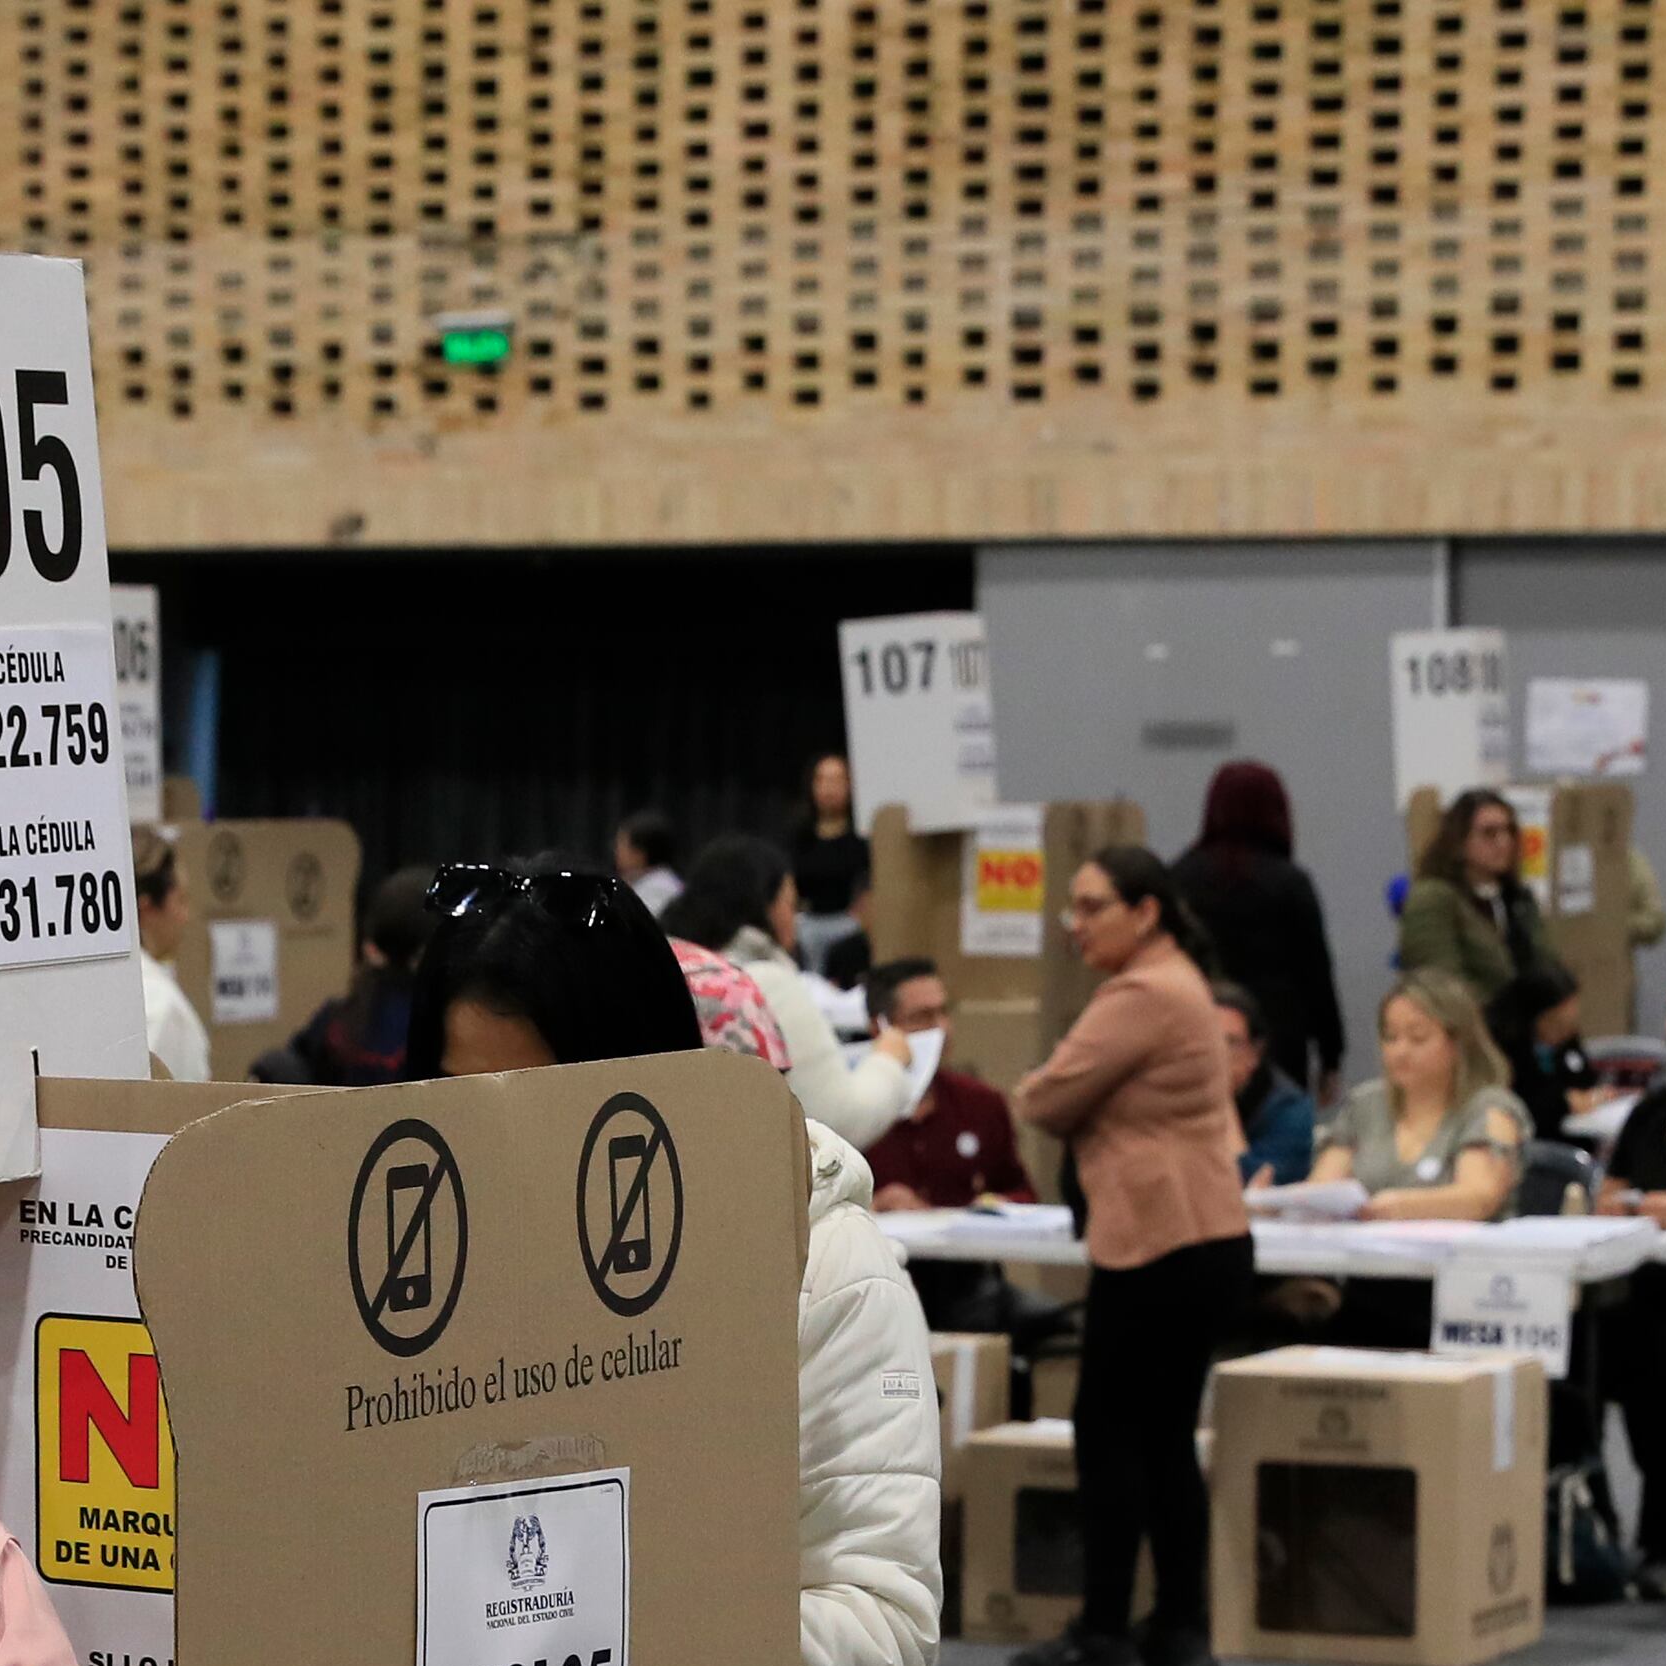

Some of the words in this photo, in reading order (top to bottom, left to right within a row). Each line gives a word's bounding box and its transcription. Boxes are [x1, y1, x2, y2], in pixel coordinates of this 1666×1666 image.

[114, 618, 149, 683] 06
[852, 641, 935, 694] 107
[25, 814, 96, 855] CÉDULA
[19, 1200, 56, 1225] EN
[68, 1203, 104, 1228] LA
[114, 1206, 133, 1230] C
[20, 1229, 133, 1250] PRECANDIDAT
[106, 1255, 128, 1269] DE
[1443, 1323, 1502, 1344] MESA
[344, 1366, 476, 1431] Prohibido
[484, 1357, 506, 1404] el
[513, 1361, 556, 1399] uso
[564, 1343, 594, 1389] de
[601, 1329, 683, 1382] celular
[59, 1348, 159, 1489] N
[79, 1507, 173, 1537] MARQU
[55, 1540, 90, 1565] DE
[100, 1544, 160, 1571] UNA
[485, 1586, 575, 1618] REGISTRADURÍA
[486, 1616, 515, 1630] NACIONAL
[517, 1614, 530, 1624] DEL
[532, 1610, 558, 1622] ESTADO
[559, 1607, 575, 1618] CIVIL
